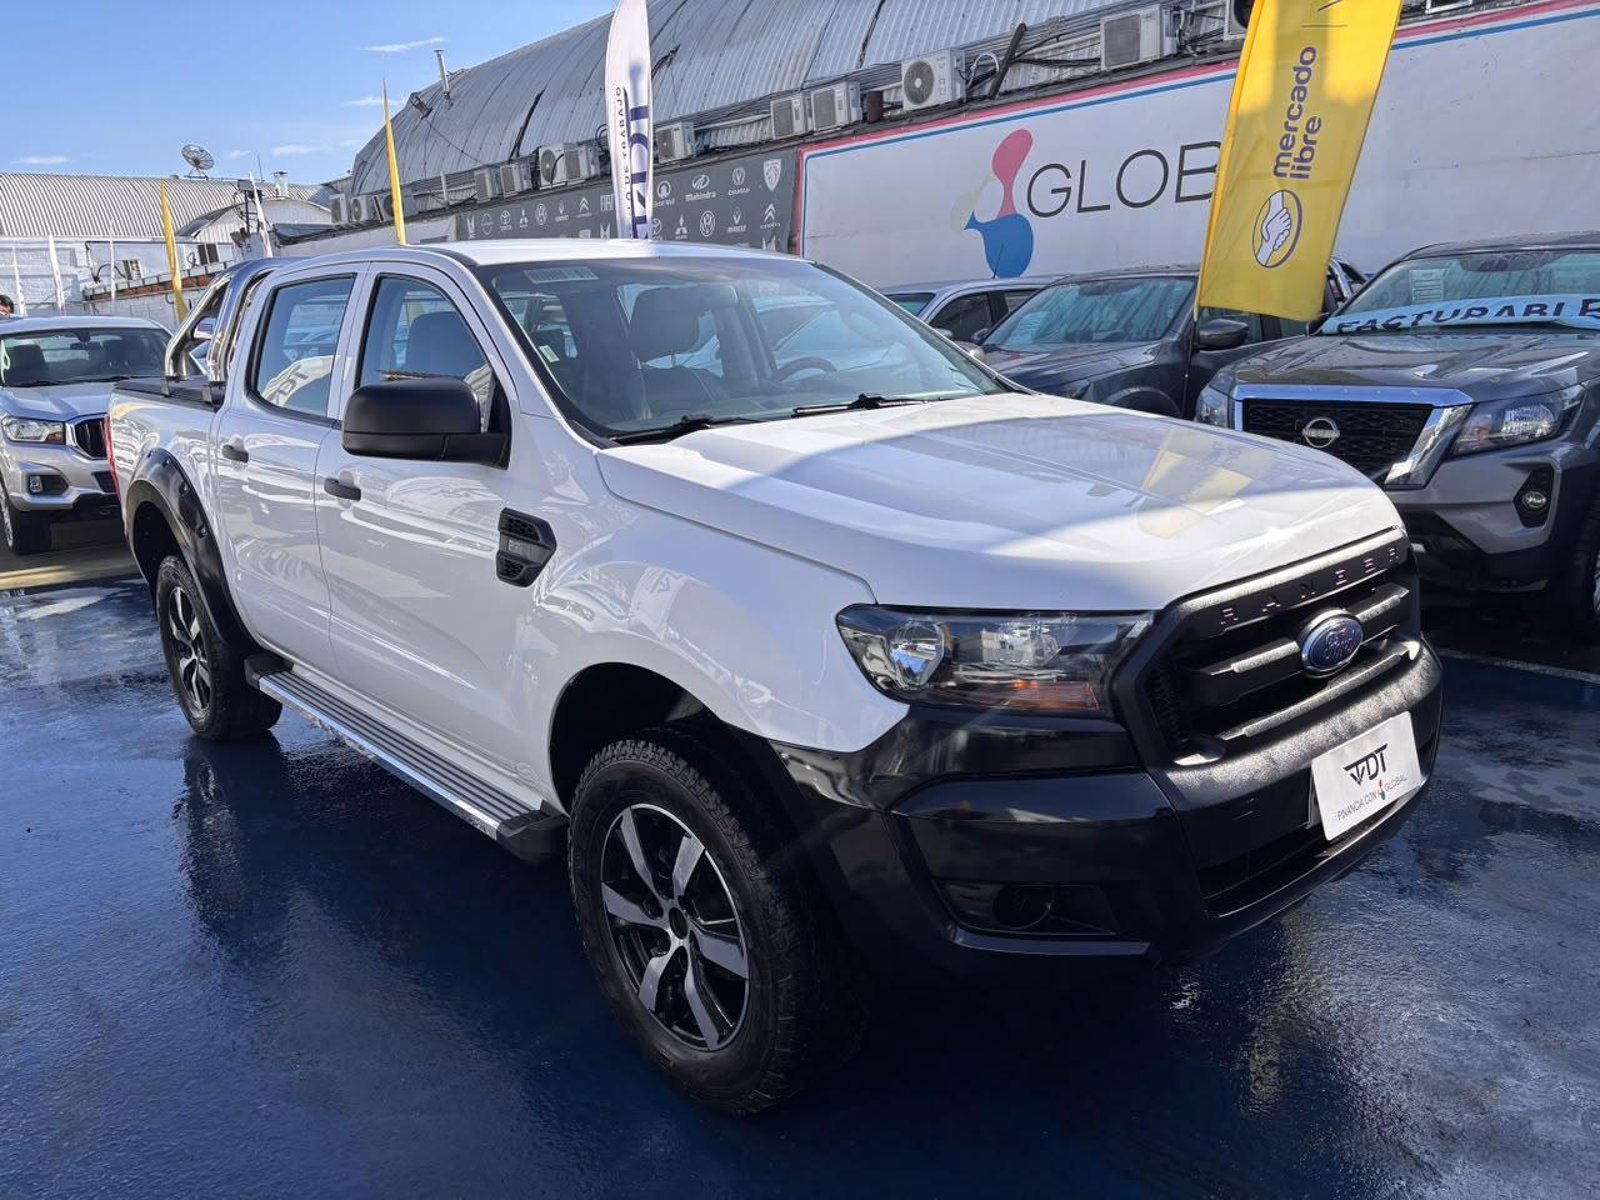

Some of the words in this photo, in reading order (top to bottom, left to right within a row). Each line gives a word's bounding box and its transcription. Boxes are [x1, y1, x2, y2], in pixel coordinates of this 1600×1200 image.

[615, 86, 628, 160] TRABAJO
[1273, 46, 1317, 179] mercado
[1290, 115, 1322, 180] libre
[685, 191, 717, 202] Mahindra
